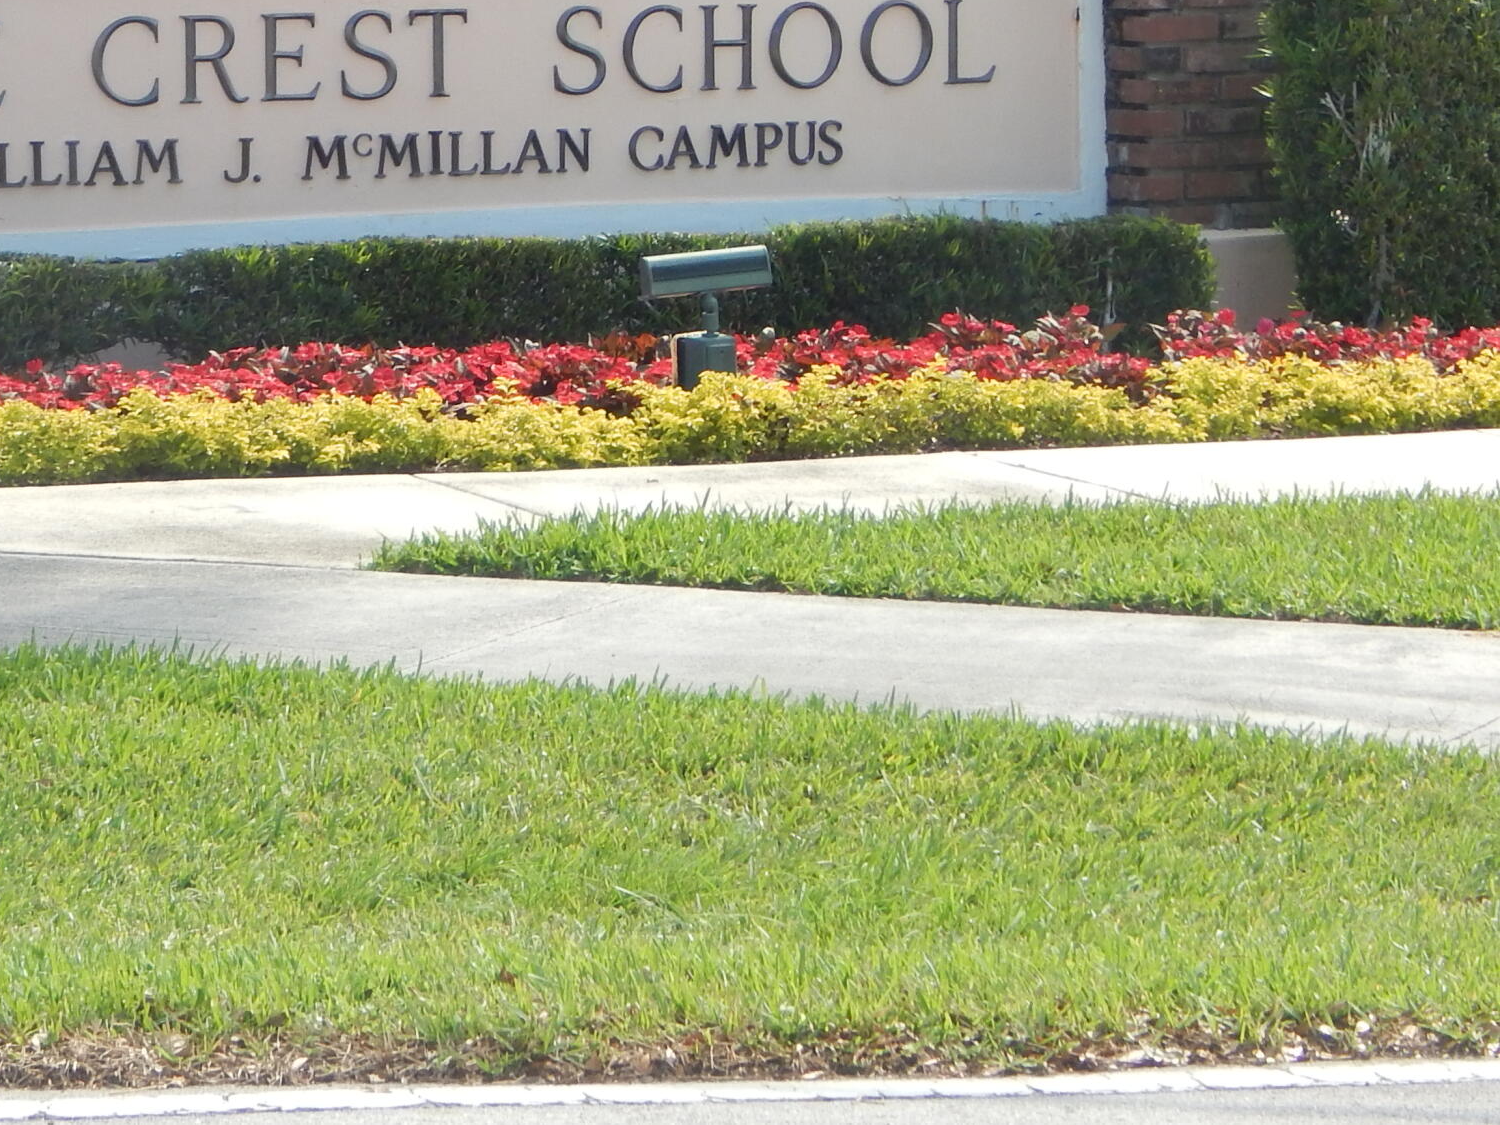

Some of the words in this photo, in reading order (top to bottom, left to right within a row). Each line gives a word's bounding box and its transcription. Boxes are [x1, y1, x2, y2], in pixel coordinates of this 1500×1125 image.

[91, 9, 468, 107] CREST
[554, 0, 997, 97] SCHOOL
[224, 137, 262, 184] J.
[629, 120, 844, 172] CAMPUS
